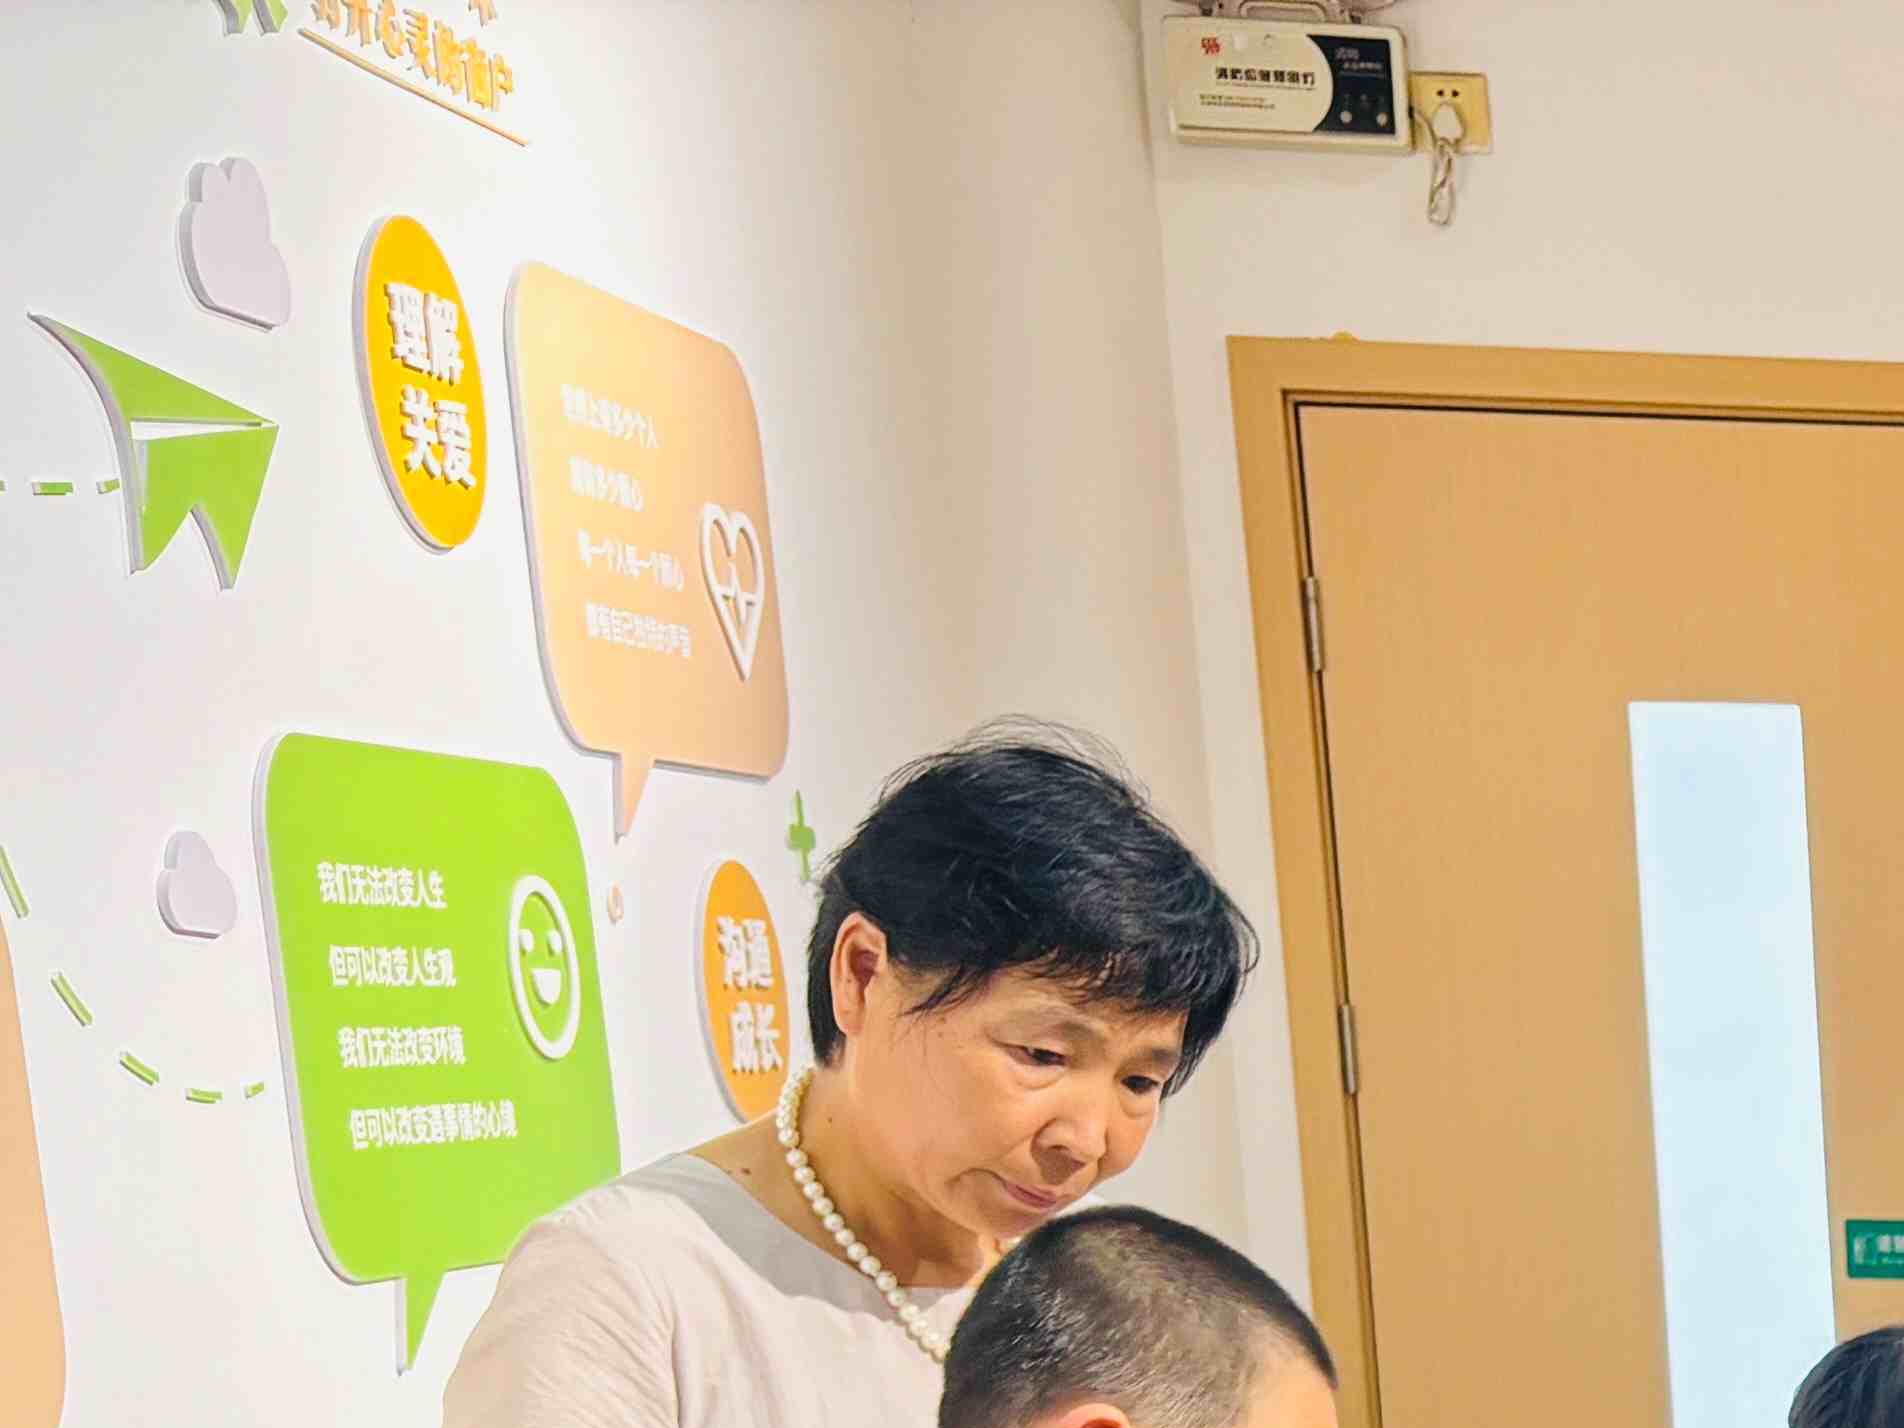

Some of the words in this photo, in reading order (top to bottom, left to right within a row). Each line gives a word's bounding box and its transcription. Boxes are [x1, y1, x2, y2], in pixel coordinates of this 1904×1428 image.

[386, 282, 464, 385] 理解
[402, 384, 477, 490] 关爱
[317, 862, 447, 909] 我们无法改变人生
[330, 944, 456, 987] 但可以改变人生观
[716, 916, 773, 990] 沟通
[338, 1026, 465, 1068] 我们无法改变环境
[730, 1002, 784, 1073] 成长
